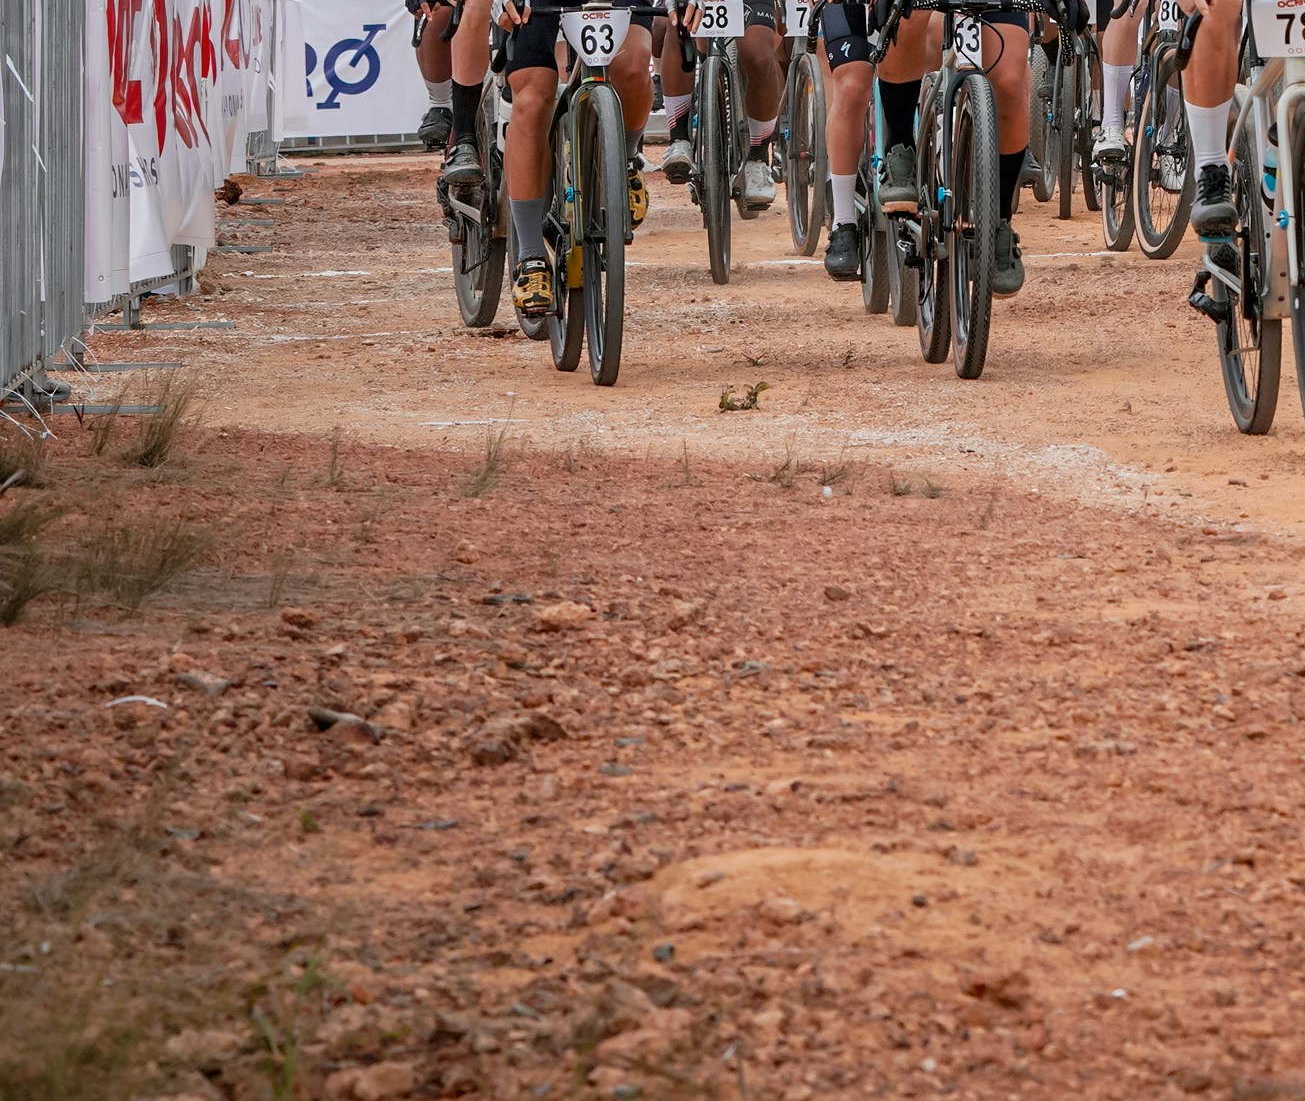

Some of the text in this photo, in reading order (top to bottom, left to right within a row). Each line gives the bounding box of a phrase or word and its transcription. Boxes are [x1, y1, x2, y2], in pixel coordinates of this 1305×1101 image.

[581, 12, 611, 20] OCBC
[702, 5, 729, 29] 58
[580, 23, 615, 56] 63
